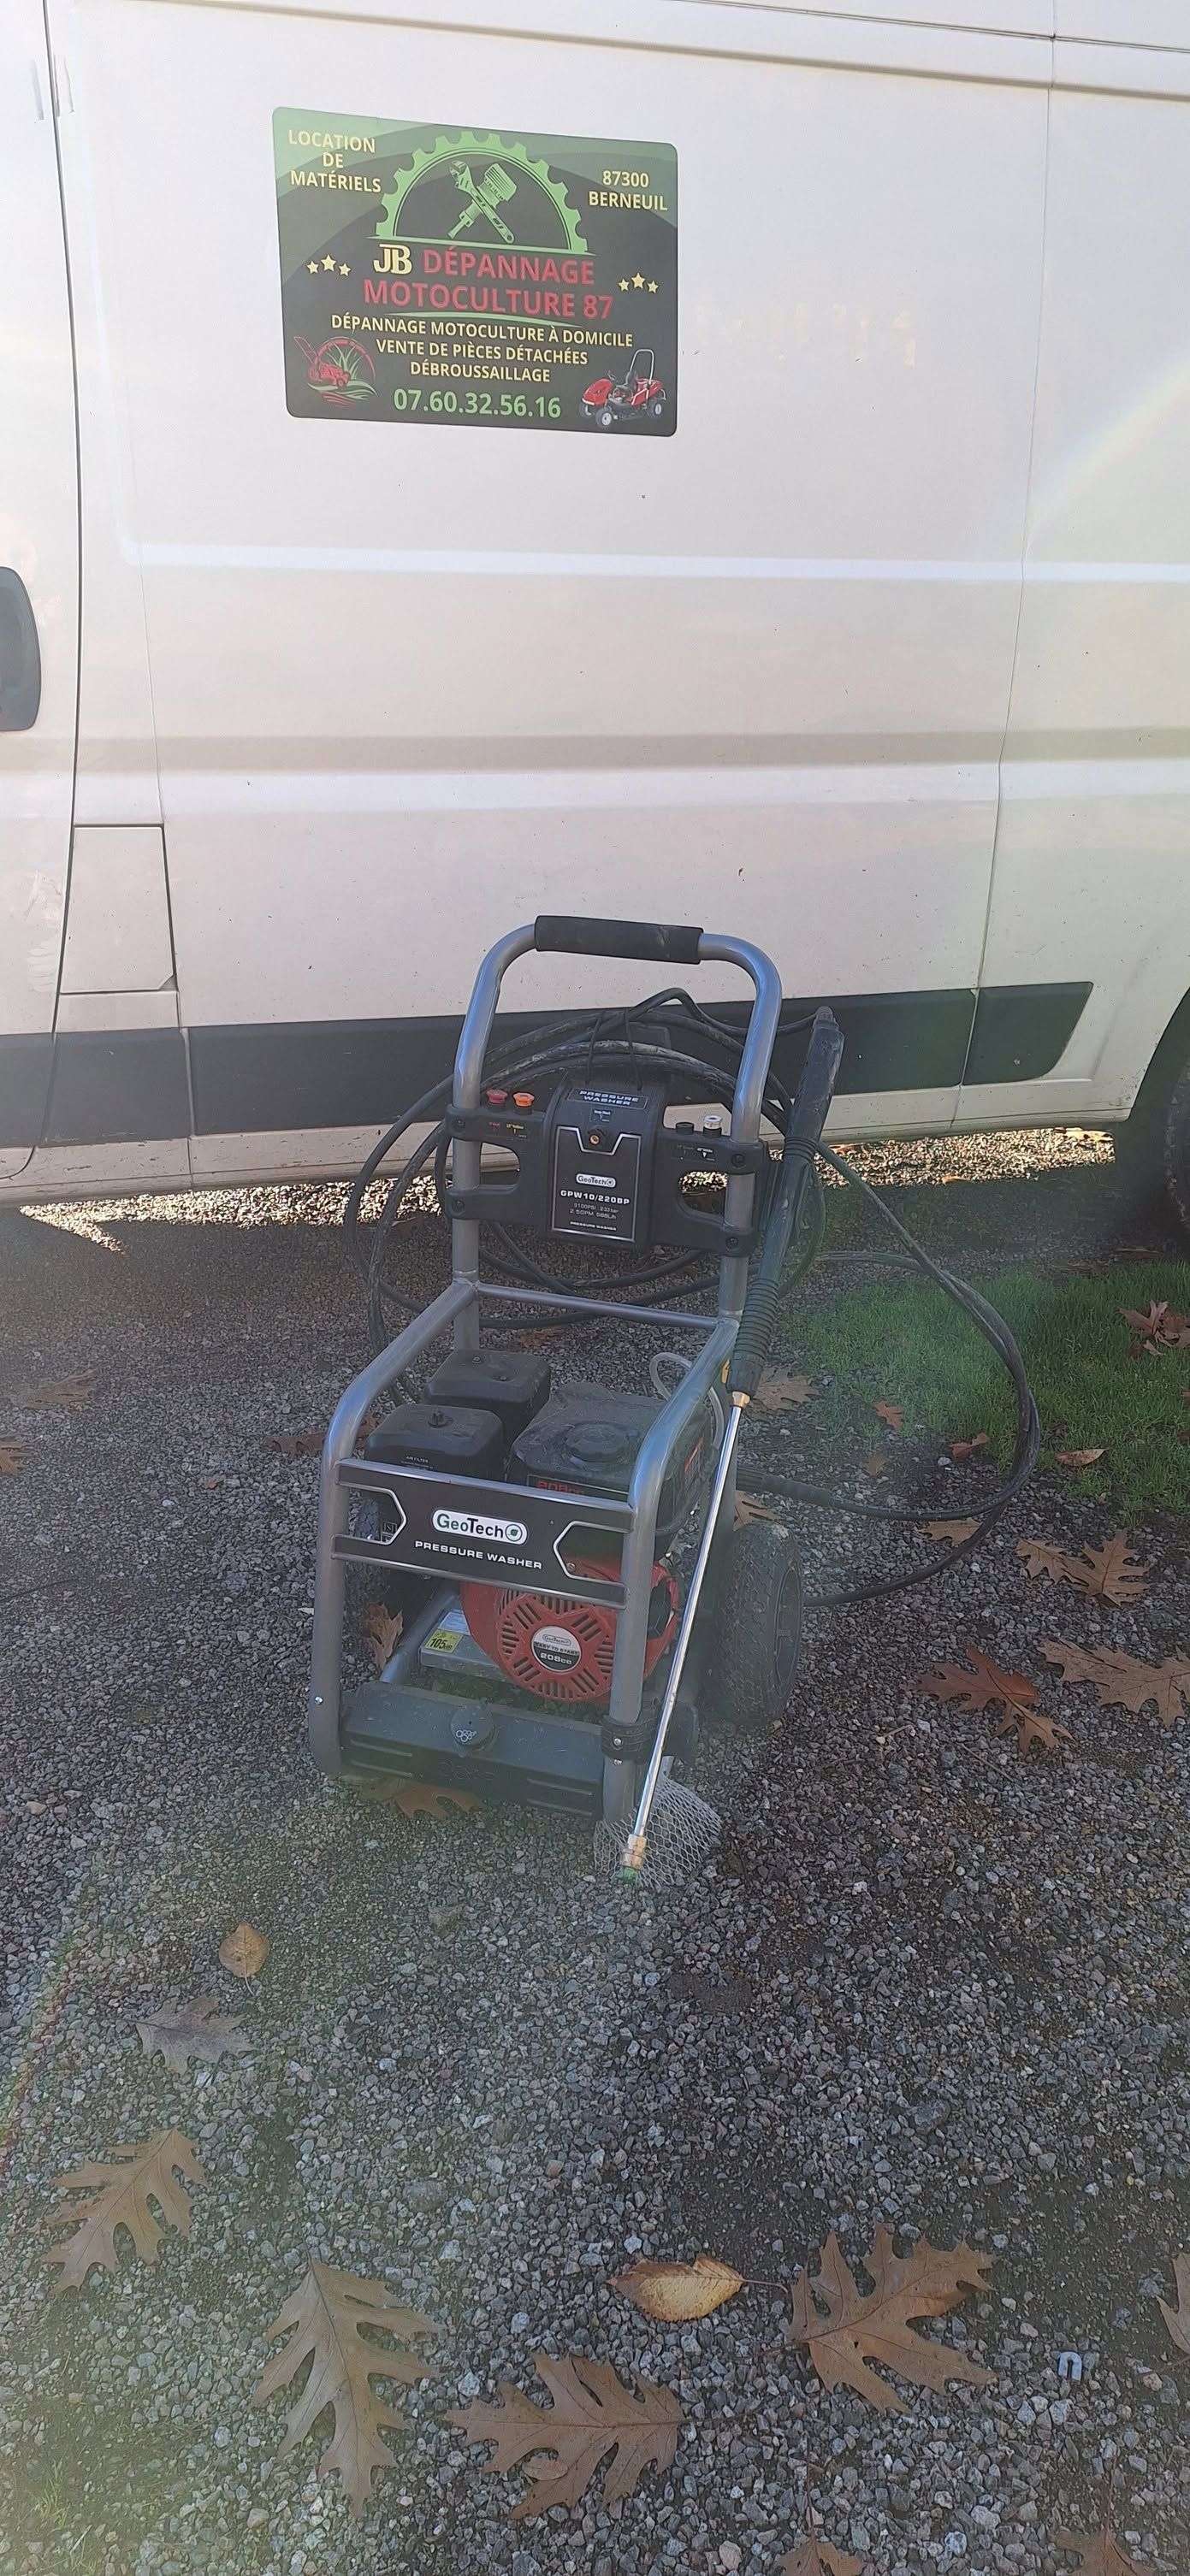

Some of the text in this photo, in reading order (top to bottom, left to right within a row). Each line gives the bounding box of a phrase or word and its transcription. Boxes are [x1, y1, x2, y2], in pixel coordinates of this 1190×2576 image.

[287, 129, 376, 153] LOCATION
[323, 152, 344, 168] DE
[290, 169, 382, 192] MATÉRIELS
[602, 170, 649, 187] 87300
[589, 191, 668, 210] BERNEUIL
[373, 244, 595, 285] JB DÉPANNAGE
[363, 279, 614, 319] MOTOCULTURE 87
[331, 314, 633, 347] DÉPANNAGE MOTOCULTURE À DOMICILE
[376, 339, 589, 364] VENTE DE PIÈCES DÉTACHÉES
[410, 359, 551, 382] DÉBROUSSAILLAGE
[393, 388, 562, 418] 07.60.32.56.16
[579, 1090, 639, 1102] PRESSURE
[583, 1096, 631, 1106] WASHER
[577, 1175, 607, 1186] GeoTech
[560, 1190, 631, 1205] GPW10/220BP
[436, 1513, 504, 1539] GeoTech
[415, 1540, 542, 1569] PRESSURE WASHER
[540, 1652, 572, 1664] 208cc
